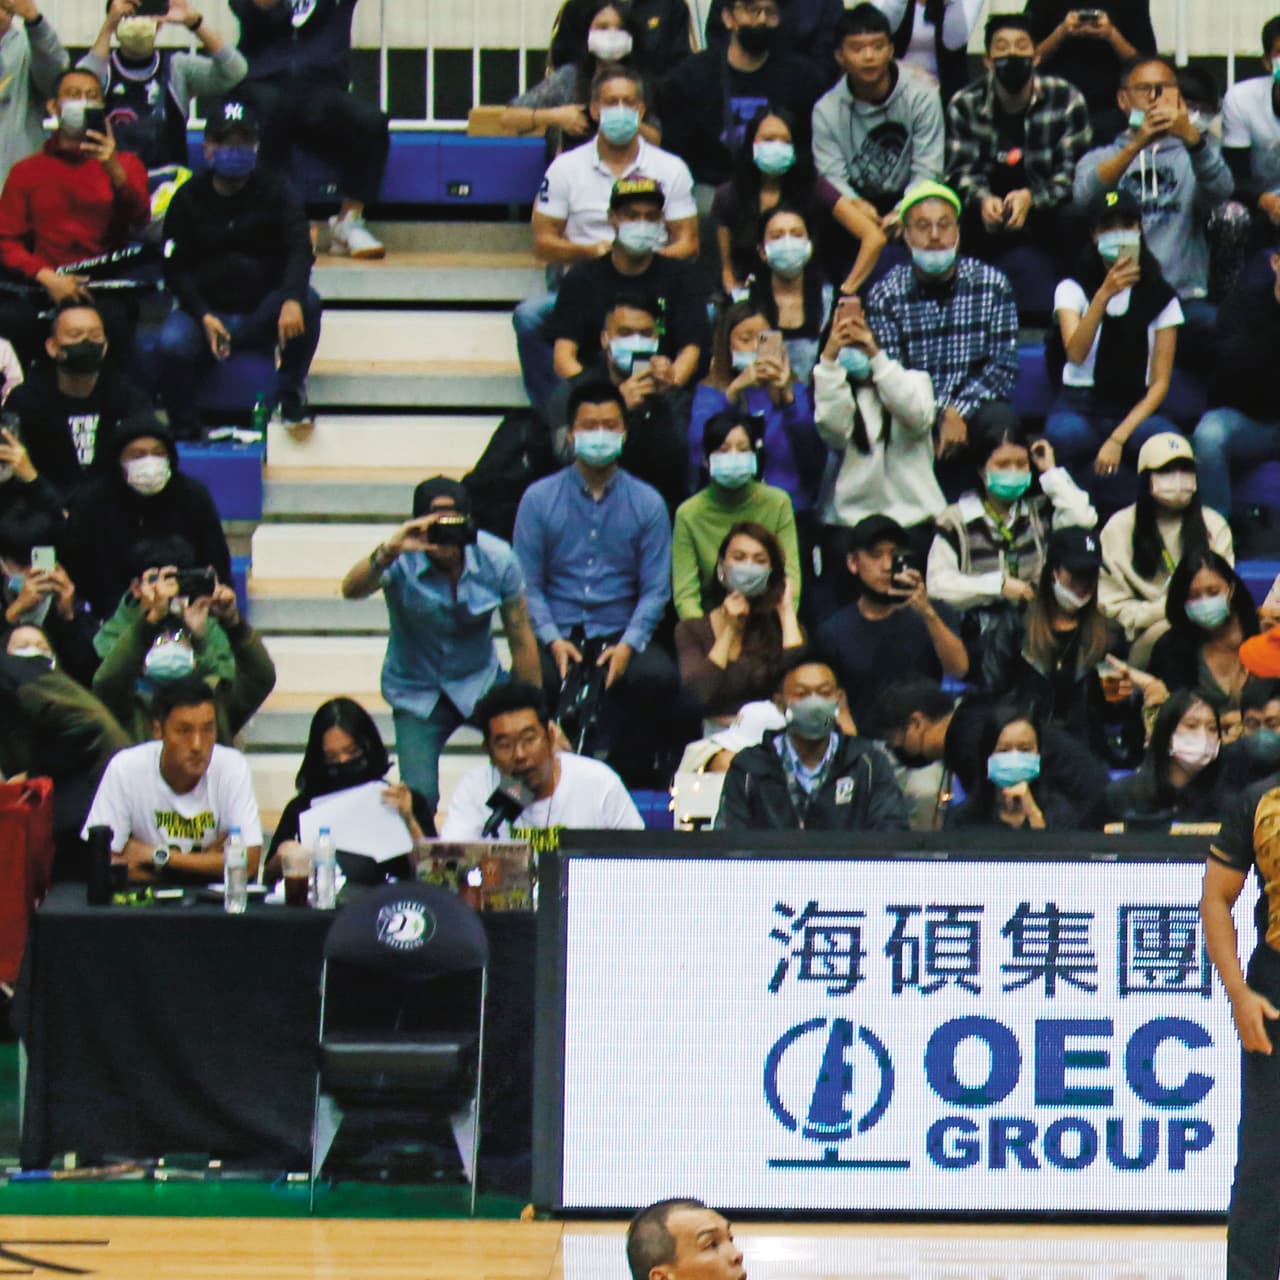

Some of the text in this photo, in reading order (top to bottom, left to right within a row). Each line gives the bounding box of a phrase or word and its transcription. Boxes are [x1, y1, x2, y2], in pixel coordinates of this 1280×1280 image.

[768, 900, 1213, 999] 海碩集團
[923, 1015, 1215, 1109] OEC
[926, 1116, 1215, 1172] GROUP
